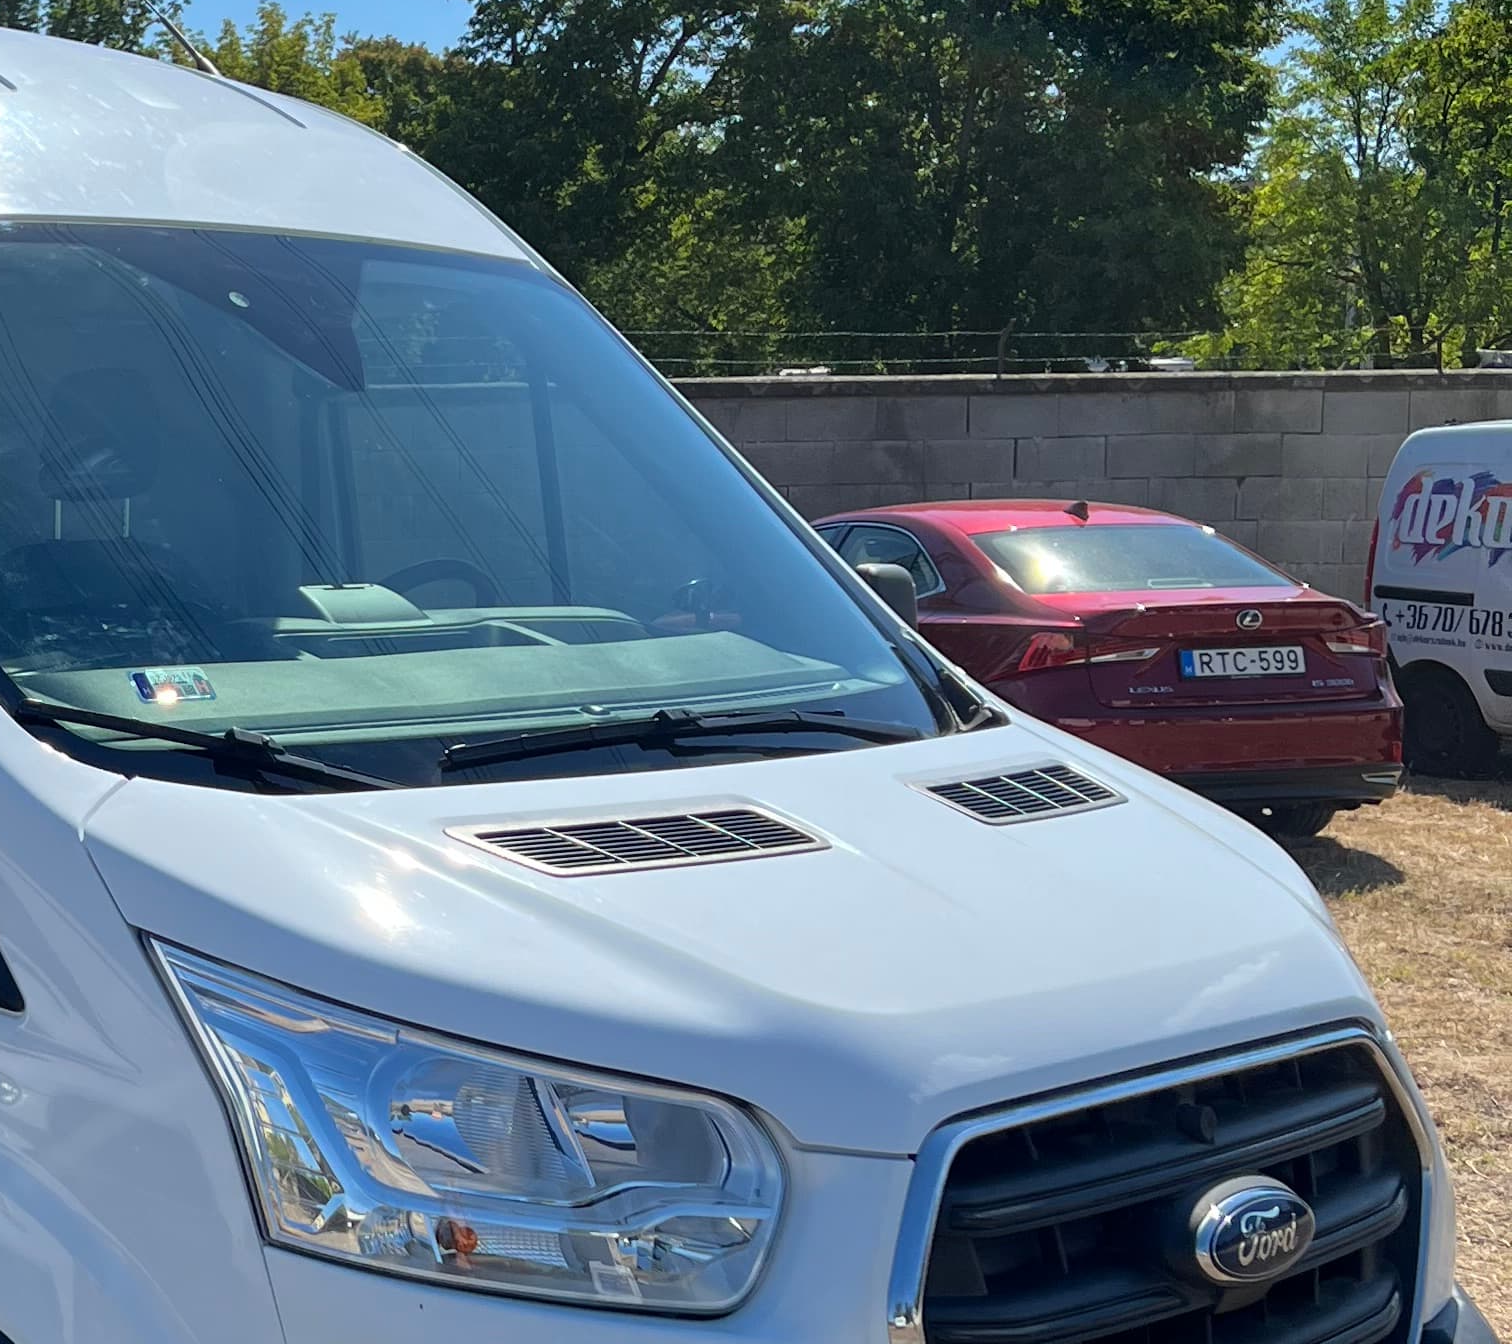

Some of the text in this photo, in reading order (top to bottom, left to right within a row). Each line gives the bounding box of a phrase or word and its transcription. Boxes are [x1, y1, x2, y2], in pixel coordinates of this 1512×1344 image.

[1396, 604, 1429, 631] +36
[1469, 609, 1503, 637] 678
[1199, 649, 1299, 674] RTC-599
[1239, 1205, 1297, 1266] Ford
